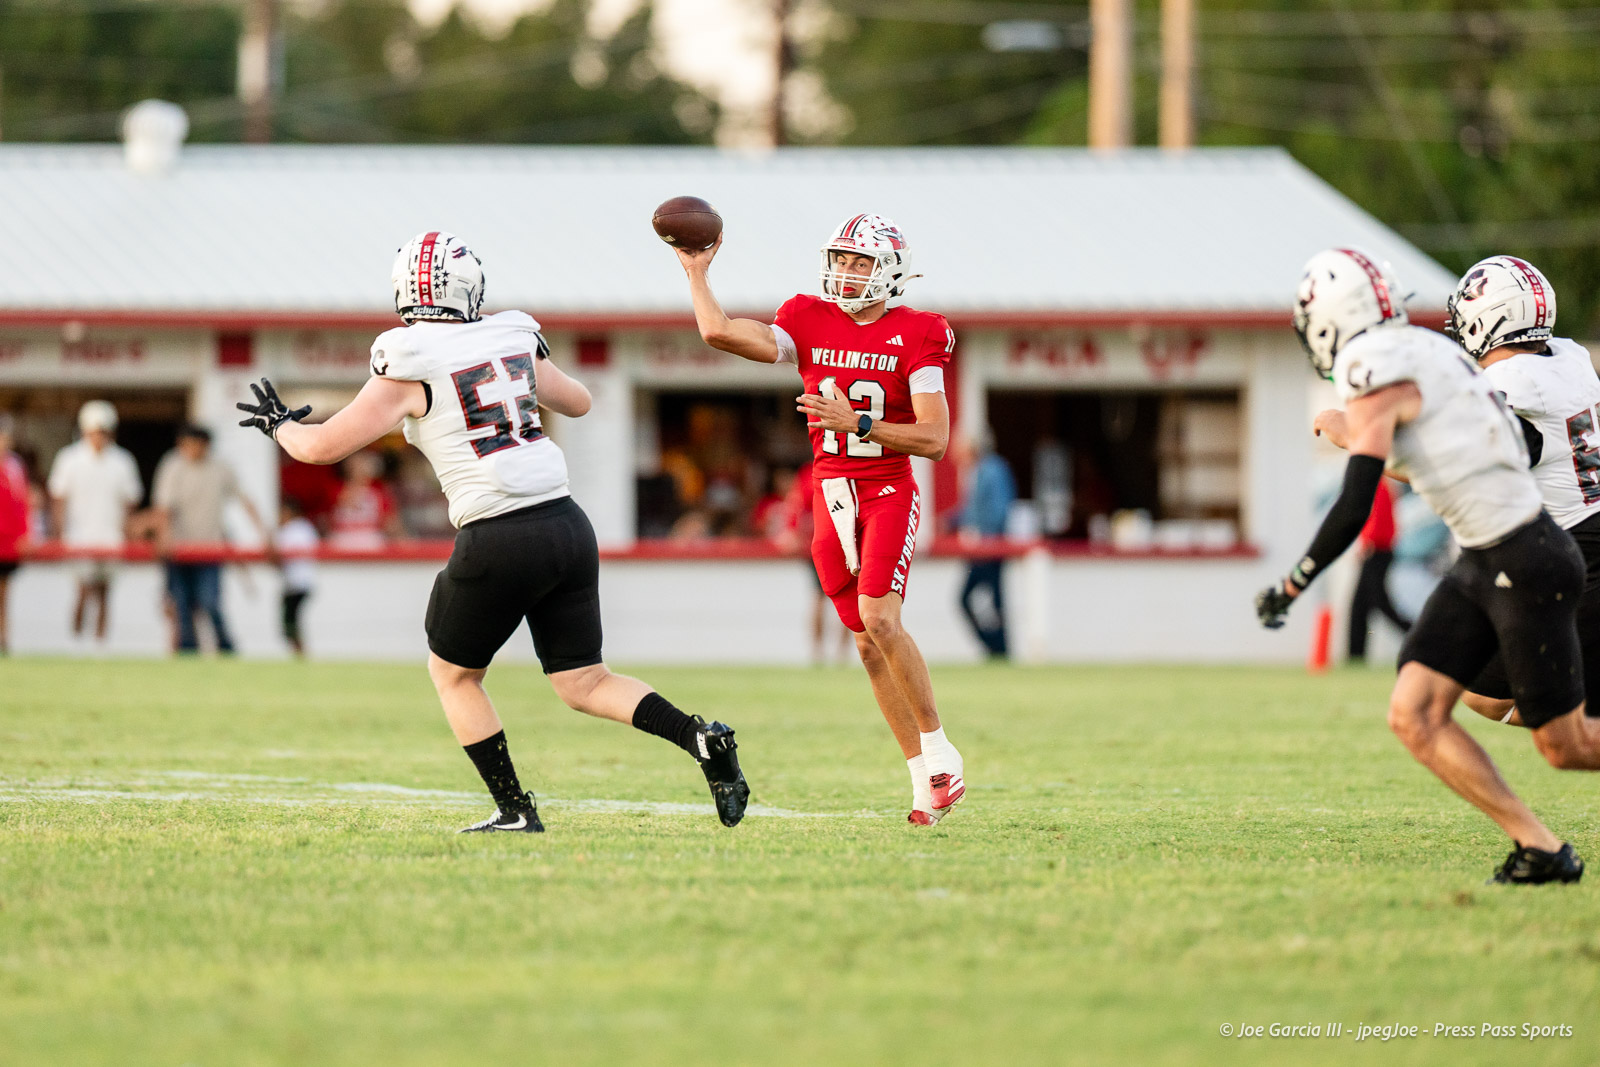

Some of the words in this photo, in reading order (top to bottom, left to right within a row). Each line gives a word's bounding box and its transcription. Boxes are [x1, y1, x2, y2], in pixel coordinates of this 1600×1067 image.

[420, 245, 432, 303] HOUNDS
[811, 347, 899, 372] WELLINGTON
[818, 376, 887, 458] 12
